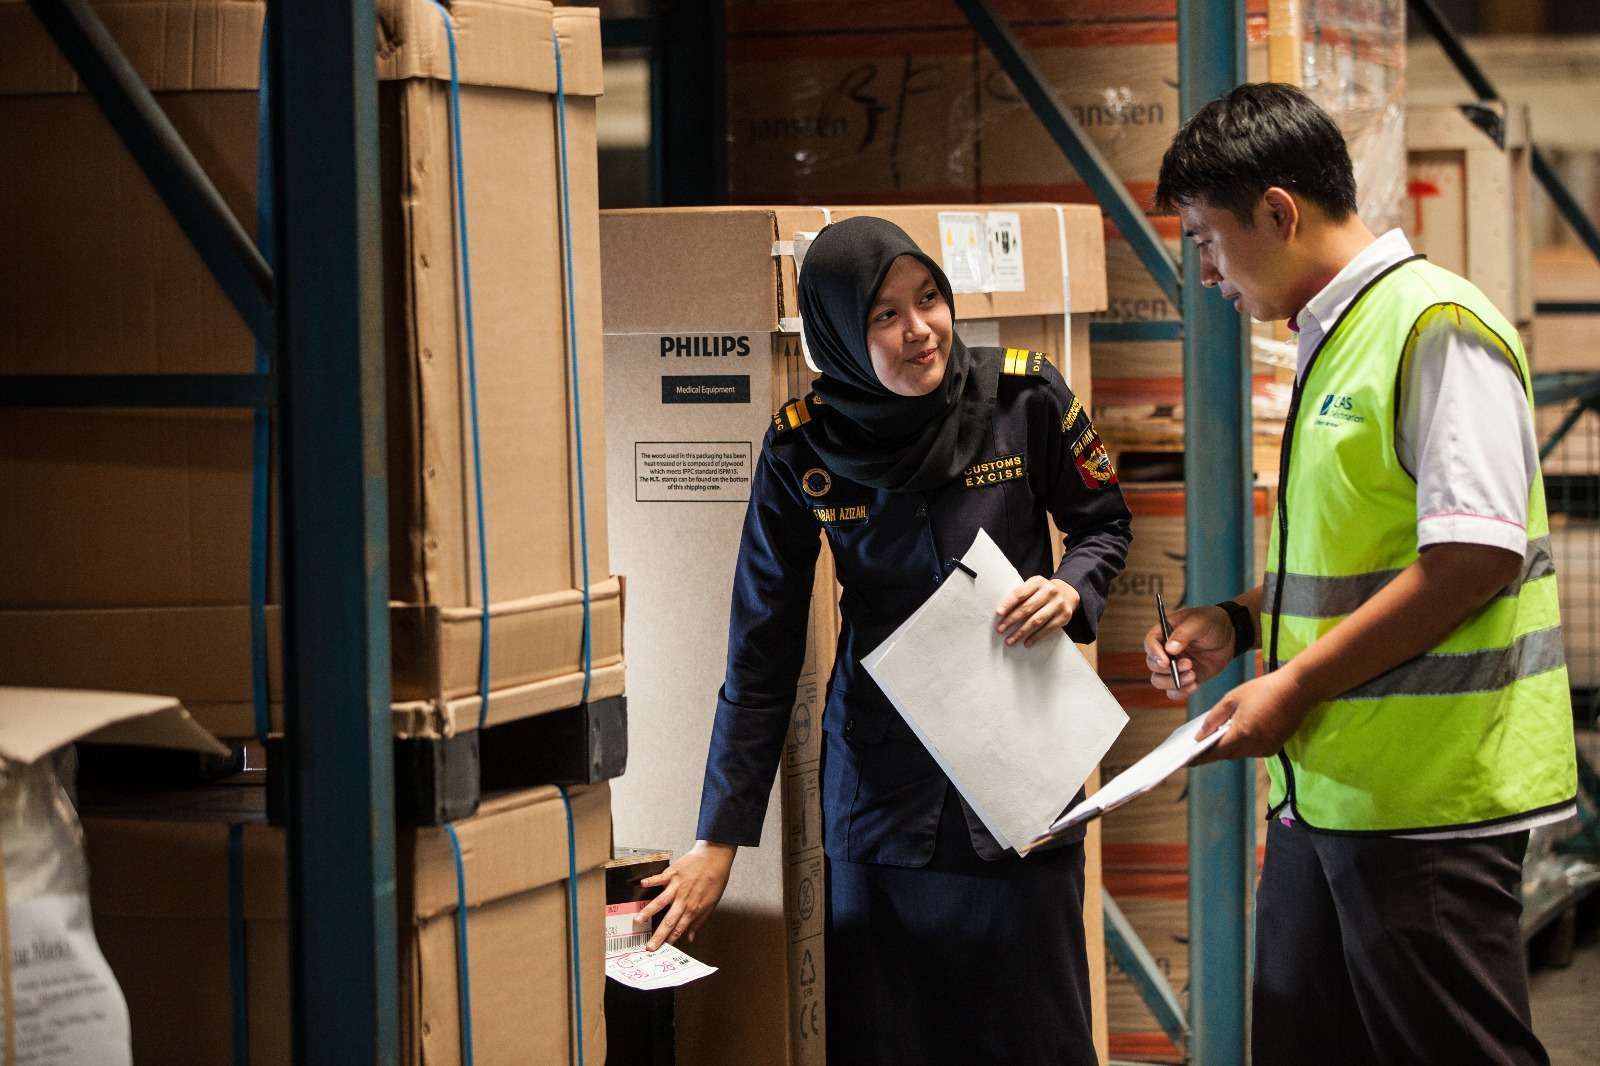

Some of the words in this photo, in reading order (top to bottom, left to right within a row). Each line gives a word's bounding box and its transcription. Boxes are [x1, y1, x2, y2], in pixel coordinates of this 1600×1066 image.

[1071, 101, 1165, 127] anssen
[660, 335, 750, 357] PHILIPS
[676, 386, 700, 394] Medical
[701, 386, 736, 395] Equipment
[773, 410, 785, 431] JBC
[964, 457, 1022, 475] CUSTOMS
[965, 467, 1023, 487] EXCISE
[839, 505, 866, 520] AZIZAH
[1108, 573, 1164, 595] ssen
